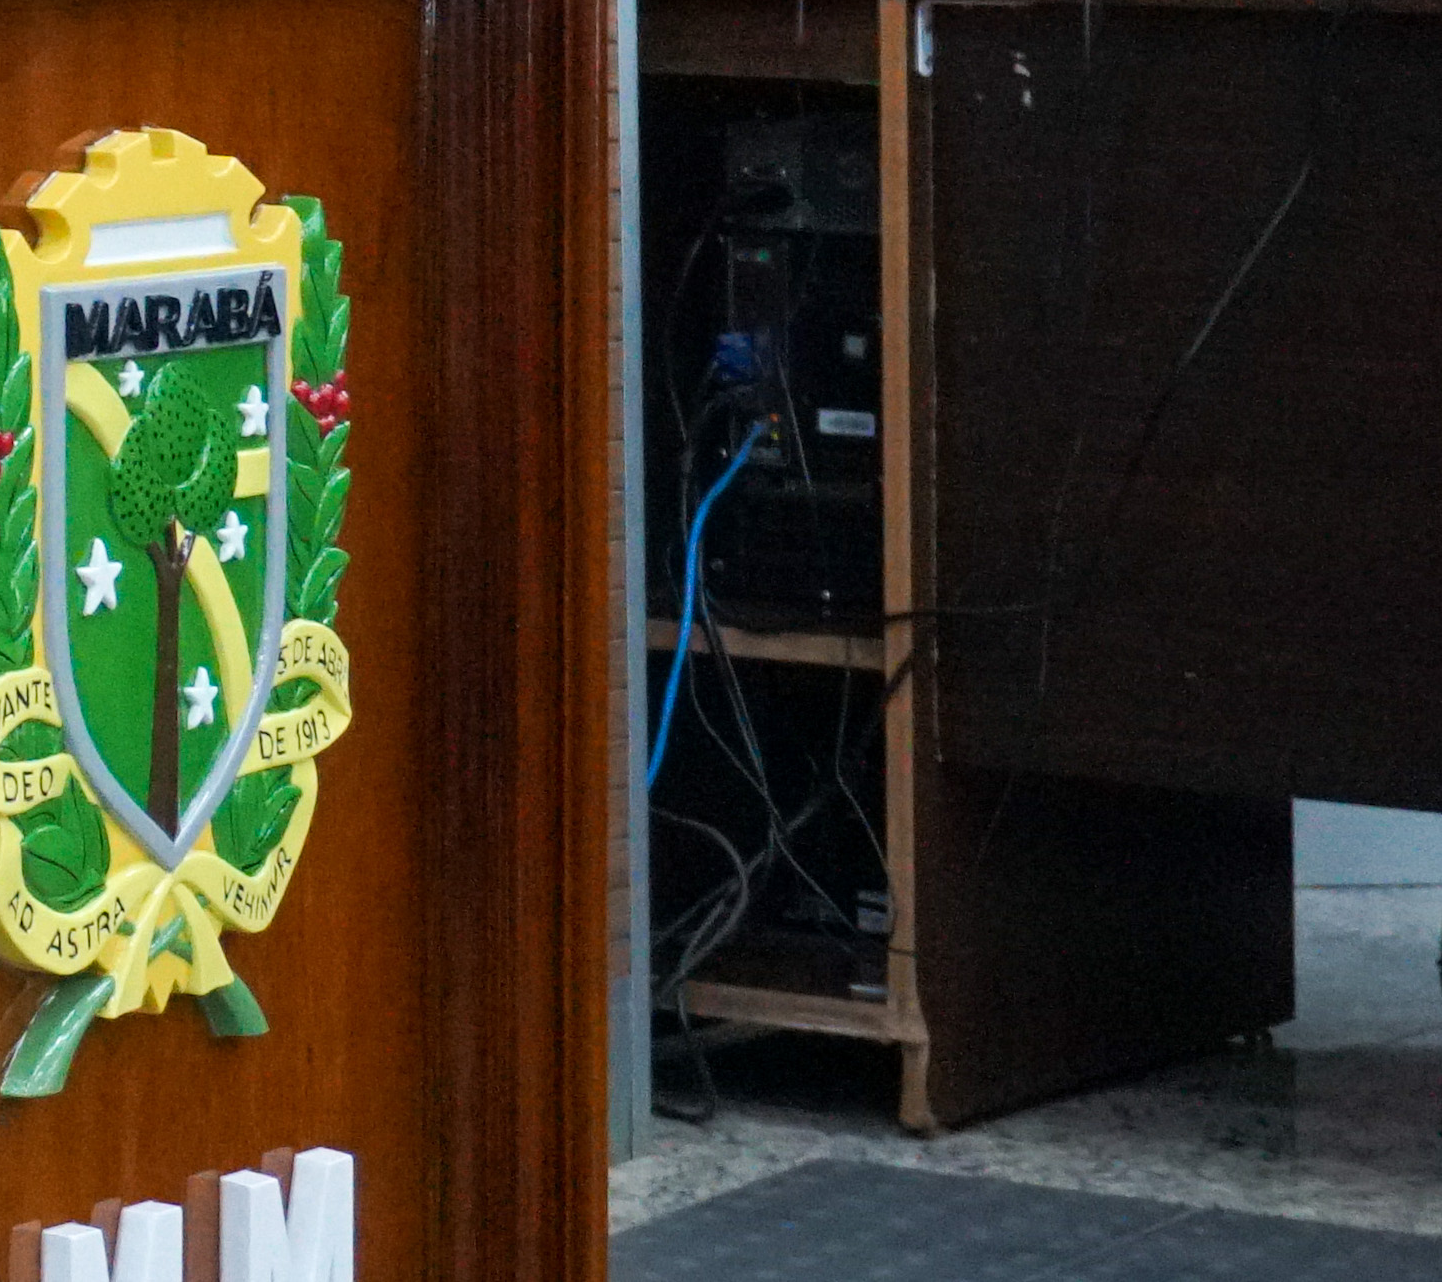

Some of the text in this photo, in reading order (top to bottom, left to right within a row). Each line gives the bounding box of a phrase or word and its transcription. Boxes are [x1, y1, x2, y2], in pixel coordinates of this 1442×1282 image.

[65, 270, 281, 359] MARABÁ
[293, 636, 313, 667] DE
[258, 710, 332, 760] DE 1913
[2, 766, 54, 803] DEO
[7, 890, 125, 959] AD ASTRA
